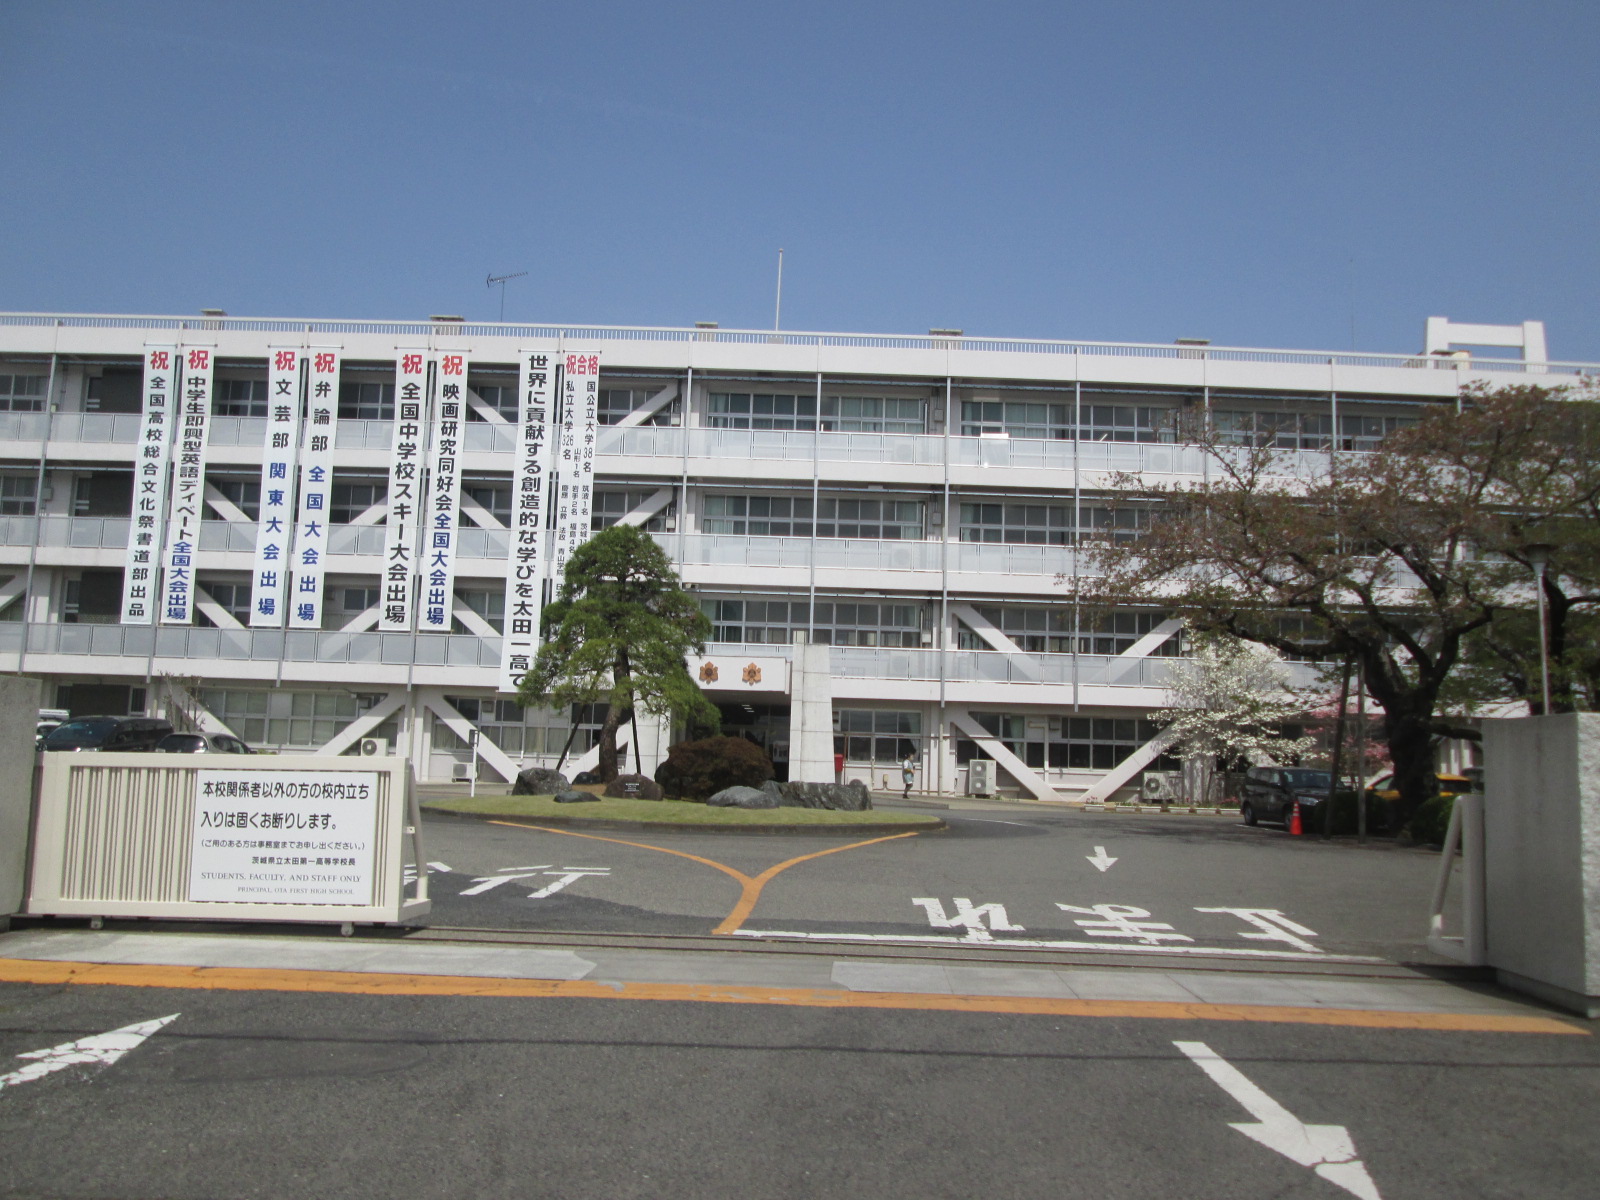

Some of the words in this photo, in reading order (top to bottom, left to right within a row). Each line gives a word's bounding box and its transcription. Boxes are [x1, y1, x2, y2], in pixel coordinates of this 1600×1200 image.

[566, 354, 599, 375] 祝合格
[202, 780, 369, 799] 本校関係者以外の方の校内立ち
[200, 811, 337, 830] 入りは固くお断りします。
[251, 856, 356, 866] 茨城県立太田第一高等学校長
[289, 874, 309, 882] AND
